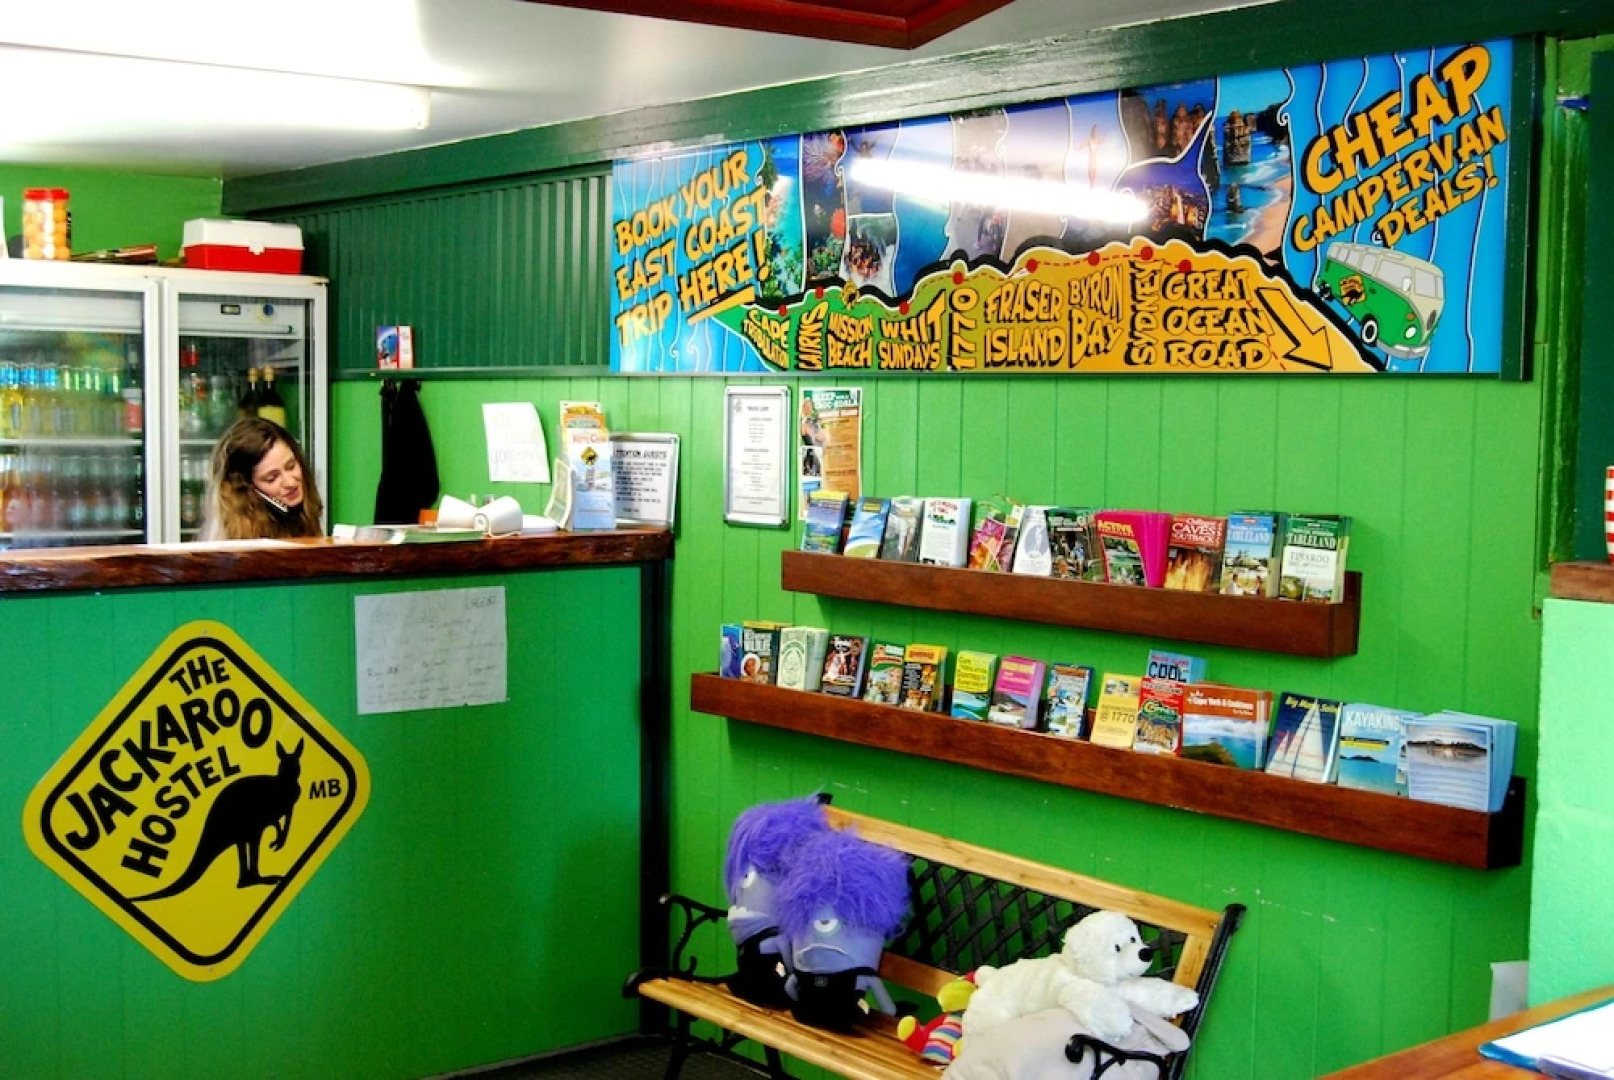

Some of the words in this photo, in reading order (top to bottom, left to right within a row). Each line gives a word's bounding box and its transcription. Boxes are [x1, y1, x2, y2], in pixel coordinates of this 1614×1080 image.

[1304, 43, 1491, 195] CHEAP
[615, 197, 679, 256] BOOK
[680, 150, 749, 219] YOUR
[1292, 107, 1508, 252] CAMPERVAN
[1376, 153, 1498, 247] DEALS!
[615, 240, 677, 302] EAST
[685, 186, 767, 262] COAST
[615, 292, 673, 347] TRIP
[678, 232, 770, 313] HERE!
[984, 279, 1064, 323] FRASER
[1068, 264, 1123, 323] BYRON
[1162, 268, 1252, 302] GREAT
[748, 308, 790, 349] CAPE
[827, 312, 874, 344] MISSION
[880, 289, 947, 344] WHIT
[952, 287, 980, 371] 1770
[1068, 306, 1123, 368] BAY
[1125, 259, 1164, 366] SYDNEY
[1163, 306, 1275, 336] OCEAN
[827, 335, 872, 369] BEACH
[878, 340, 942, 370] SUNDAYS
[984, 327, 1067, 368] ISLAND
[1163, 339, 1273, 370] ROAD
[1172, 522, 1216, 536] CAVES
[168, 655, 231, 695] THE
[1111, 710, 1134, 724] 1770
[65, 688, 273, 852] JACKAROO
[308, 778, 342, 800] MB
[120, 745, 241, 879] HOSTEL
